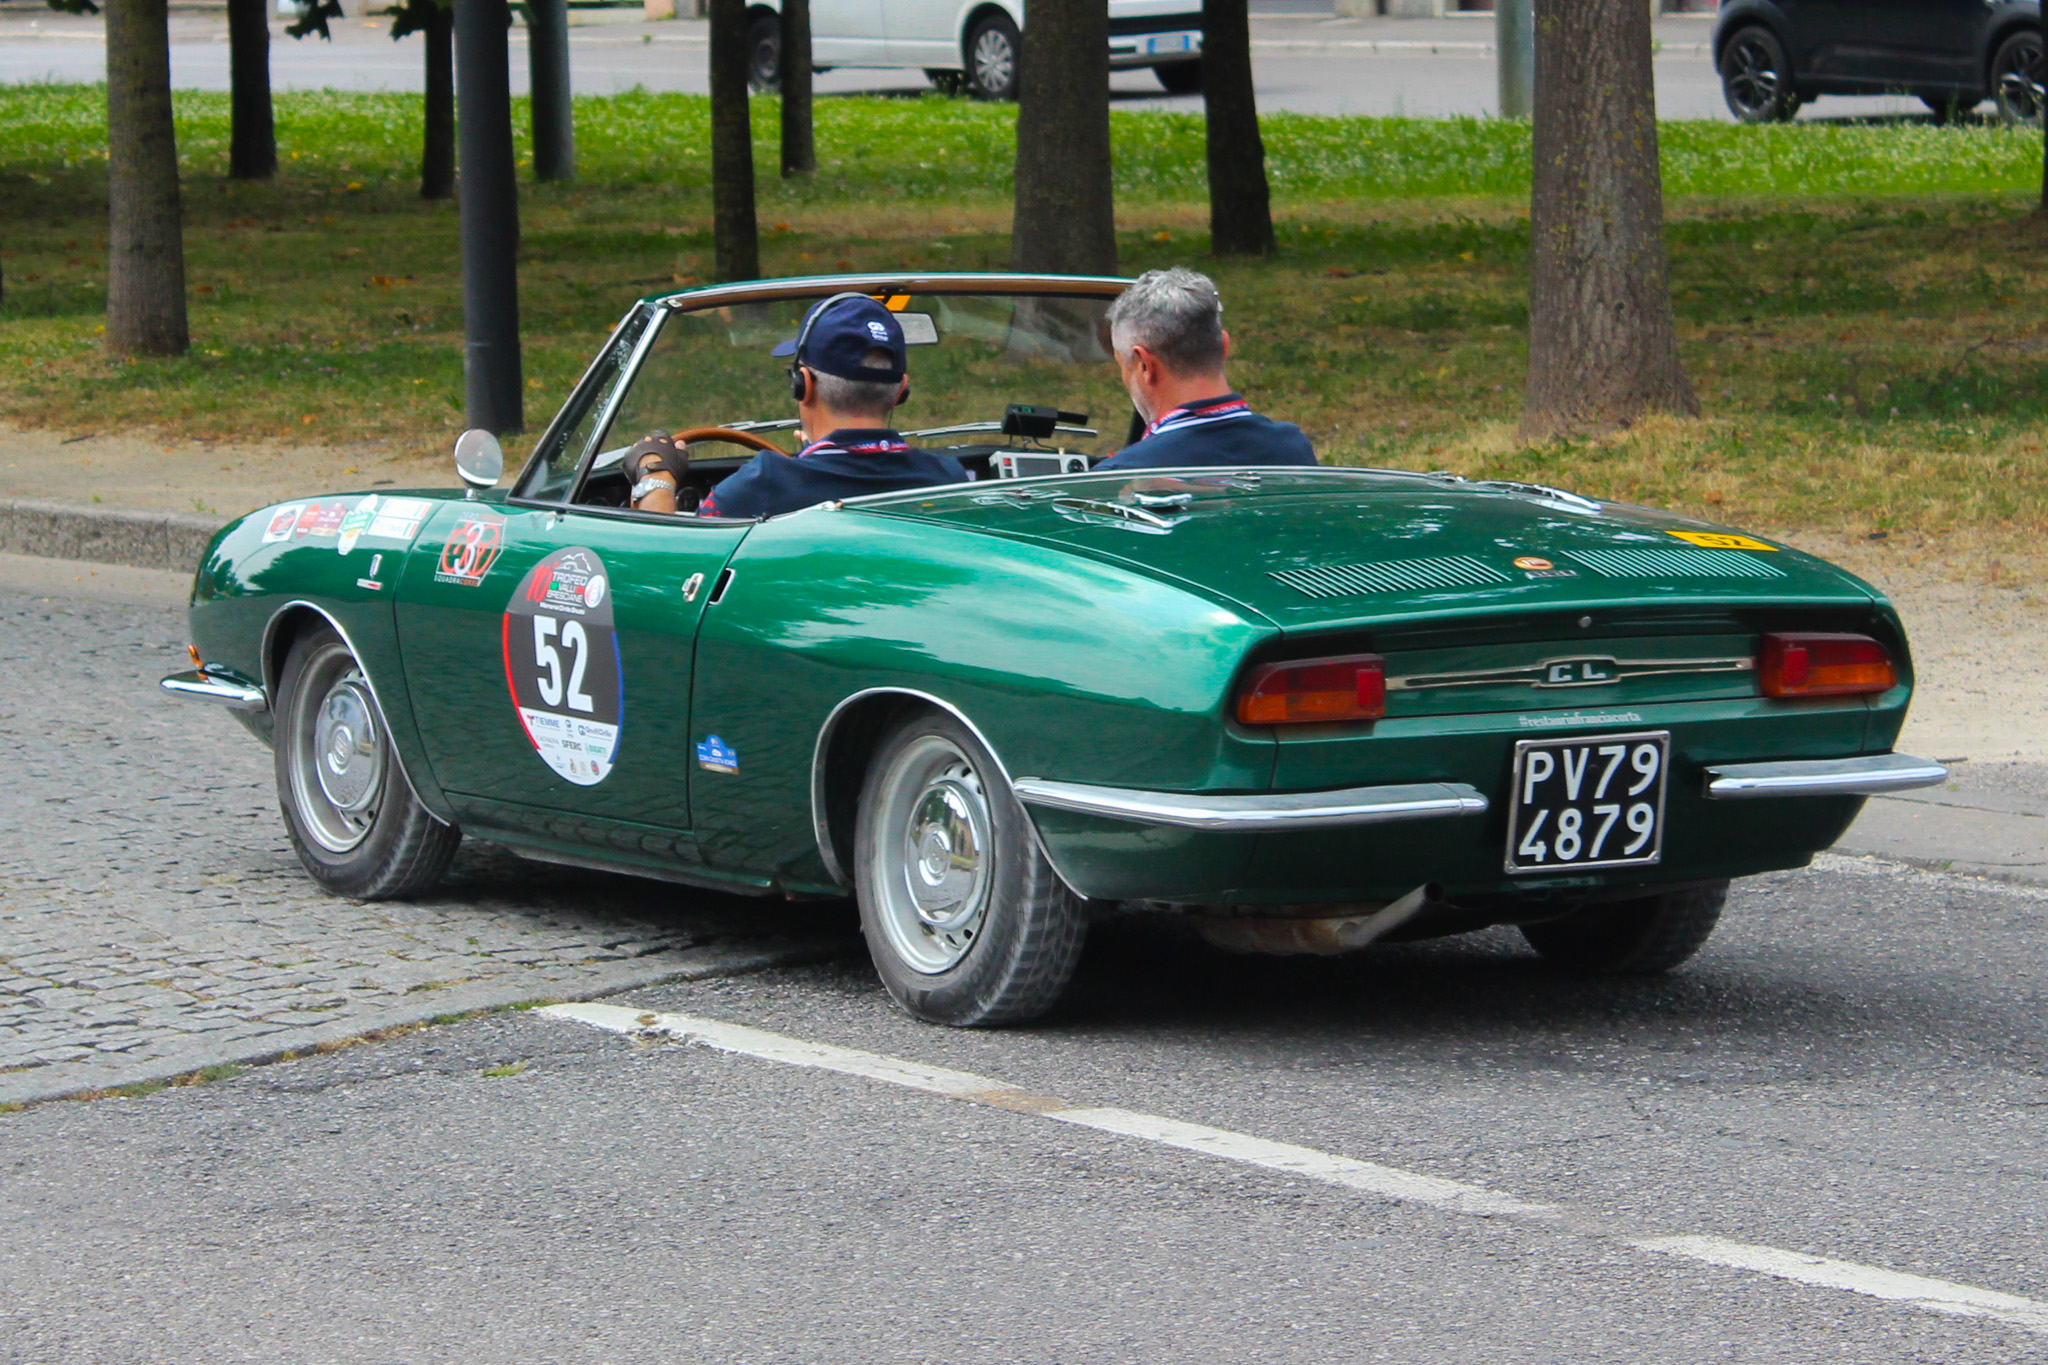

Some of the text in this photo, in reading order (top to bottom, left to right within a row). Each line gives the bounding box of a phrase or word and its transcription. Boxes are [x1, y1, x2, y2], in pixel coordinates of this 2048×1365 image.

[1695, 535, 1755, 547] 52
[553, 571, 588, 586] TROFEO
[558, 583, 576, 593] VALLI
[546, 589, 584, 604] BRESCIANE
[533, 614, 594, 713] 52
[1518, 802, 1655, 863] 4879
